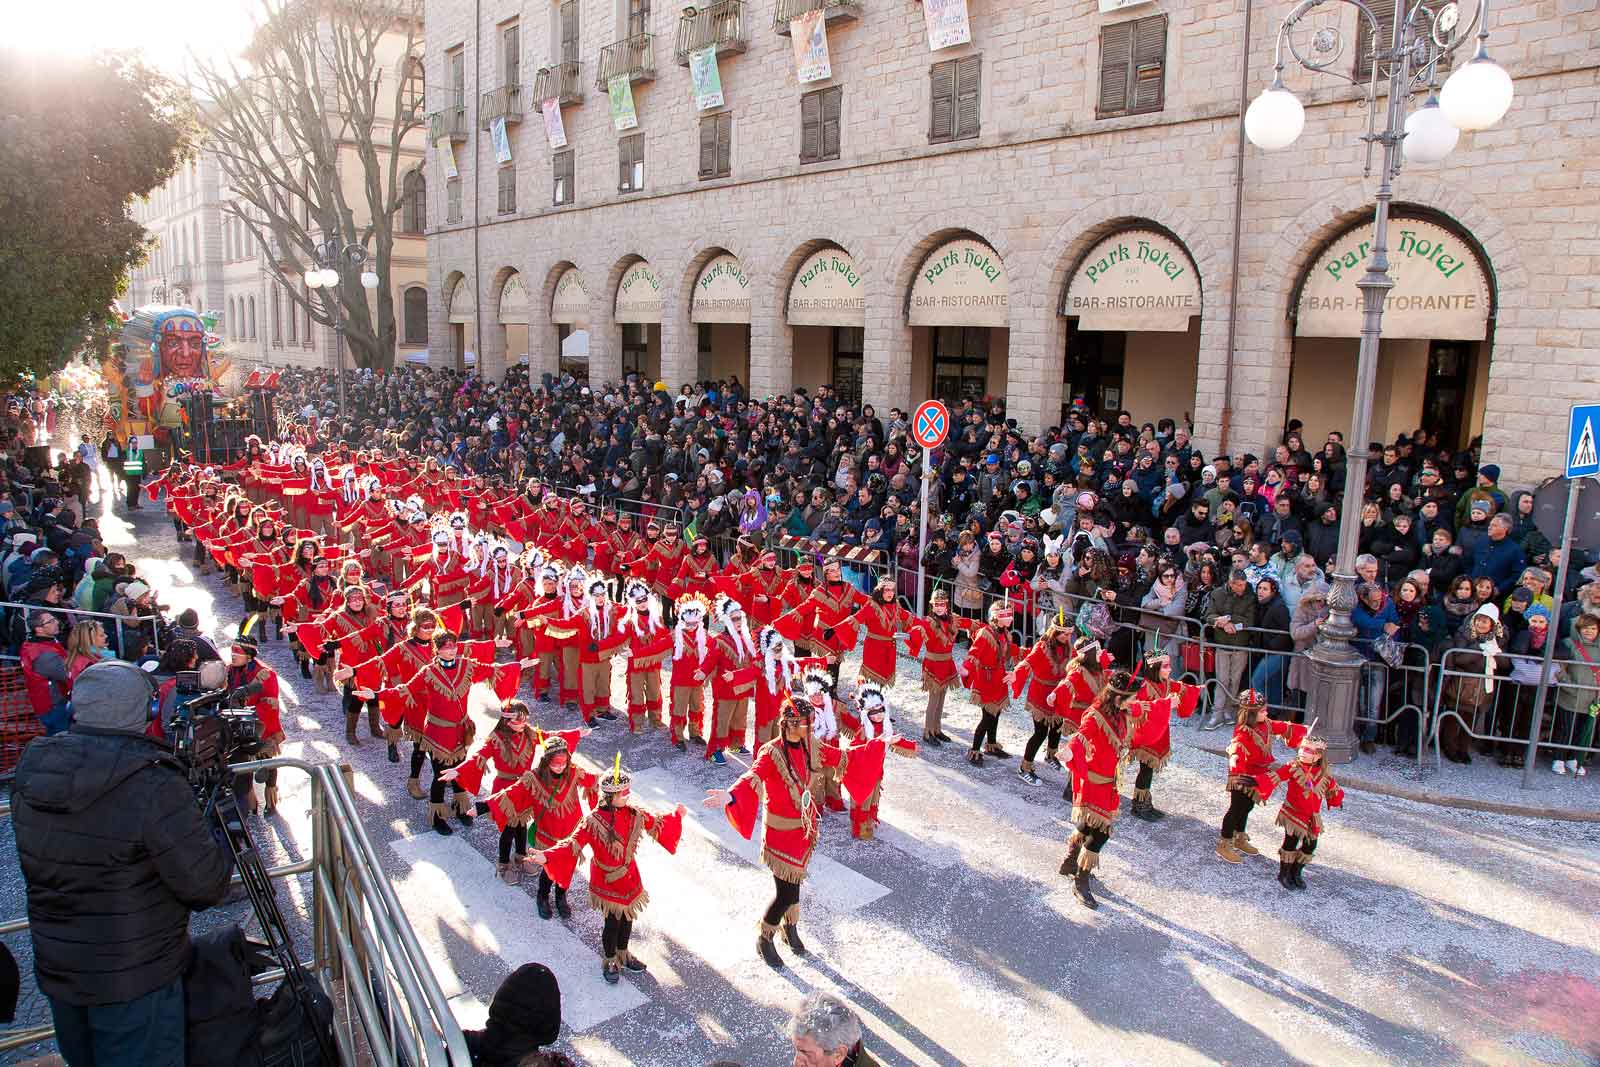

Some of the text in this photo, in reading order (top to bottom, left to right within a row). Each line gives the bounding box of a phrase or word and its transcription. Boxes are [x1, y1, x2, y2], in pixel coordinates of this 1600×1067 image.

[915, 294, 1009, 307] BAR-RISTORANTE
[1073, 294, 1194, 309] BAR-RISTORANTE
[1309, 294, 1477, 311] BAR-RTORANTE
